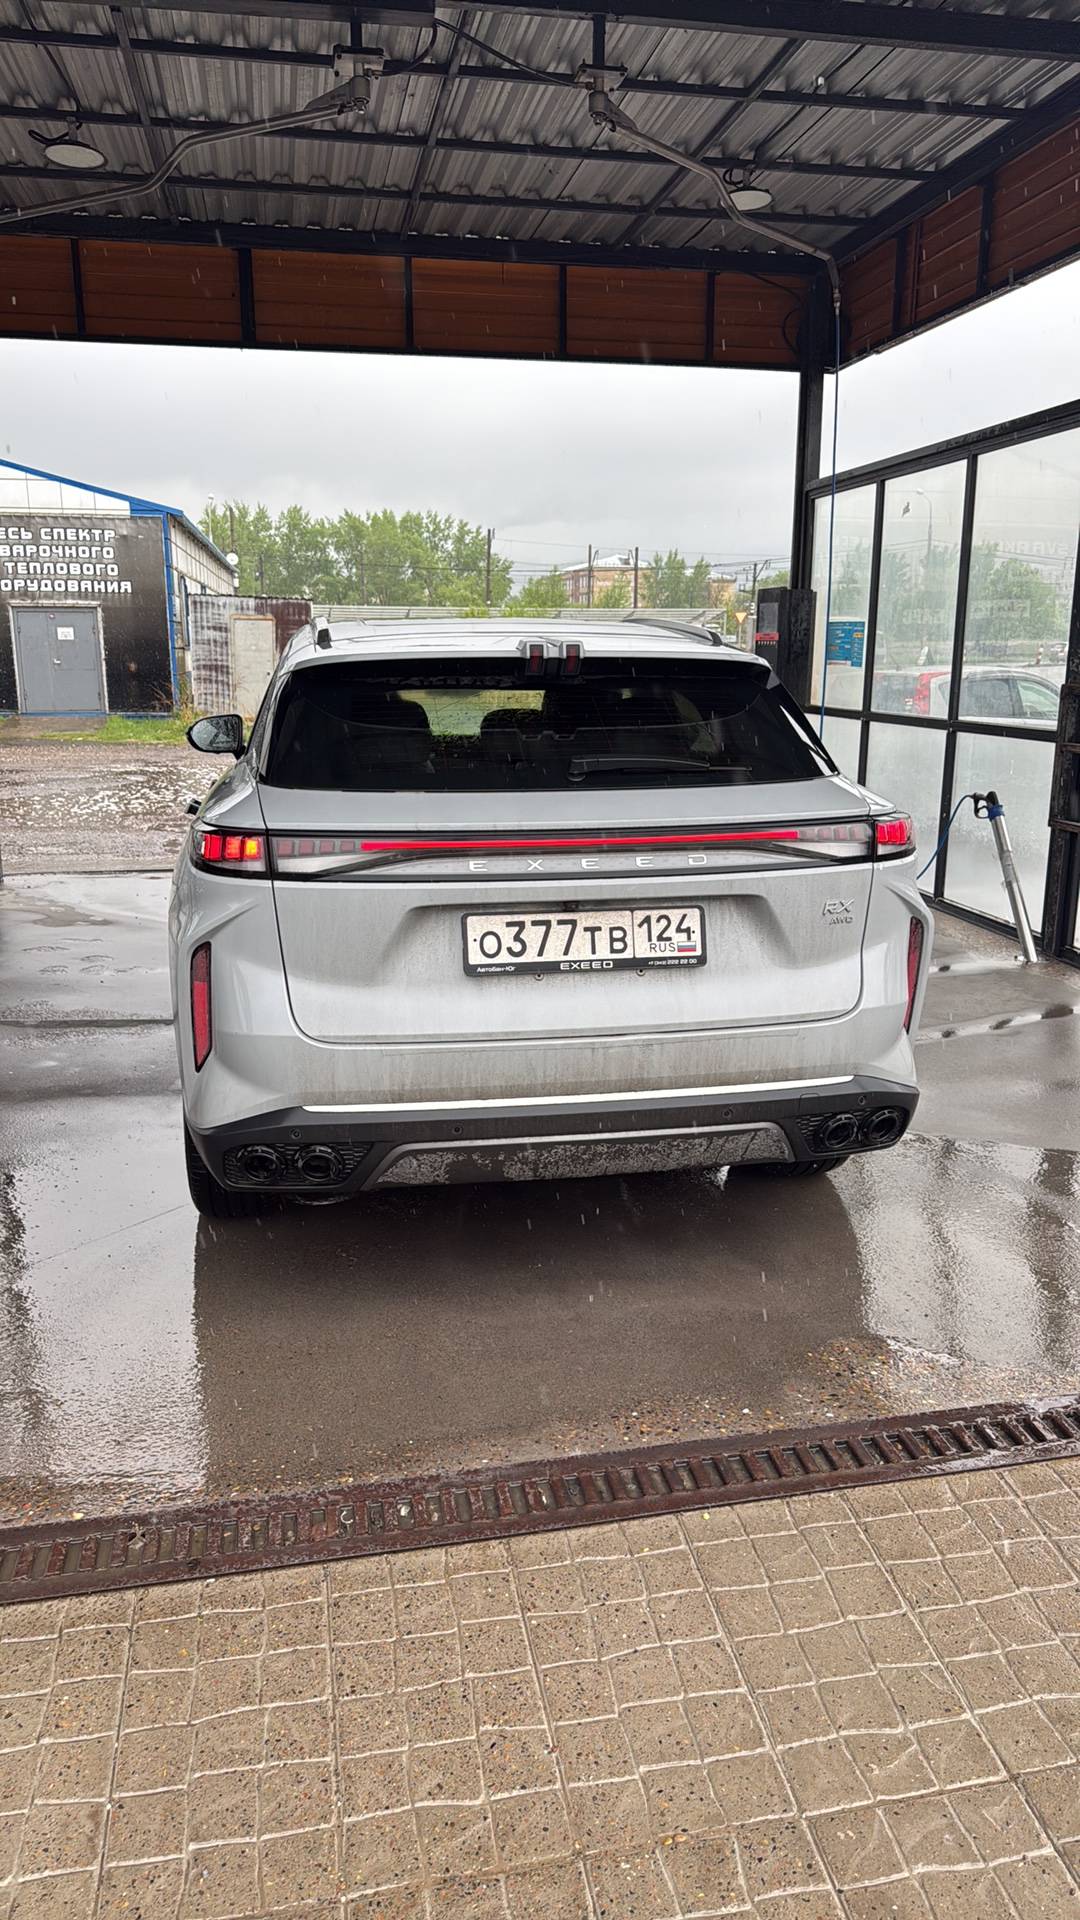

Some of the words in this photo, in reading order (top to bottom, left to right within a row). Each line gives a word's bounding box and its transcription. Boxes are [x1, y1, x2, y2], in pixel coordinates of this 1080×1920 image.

[40, 528, 116, 542] СПЕКТР
[0, 545, 114, 558] ВАРОЧНОГО
[4, 562, 119, 576] ТЕПЛОВОГО
[0, 580, 132, 593] ОРУДОВАНИЯ
[469, 854, 707, 872] EXEED
[823, 898, 855, 916] RX
[637, 913, 692, 943] 124
[649, 942, 676, 953] RUS
[560, 960, 613, 971] EXEED
